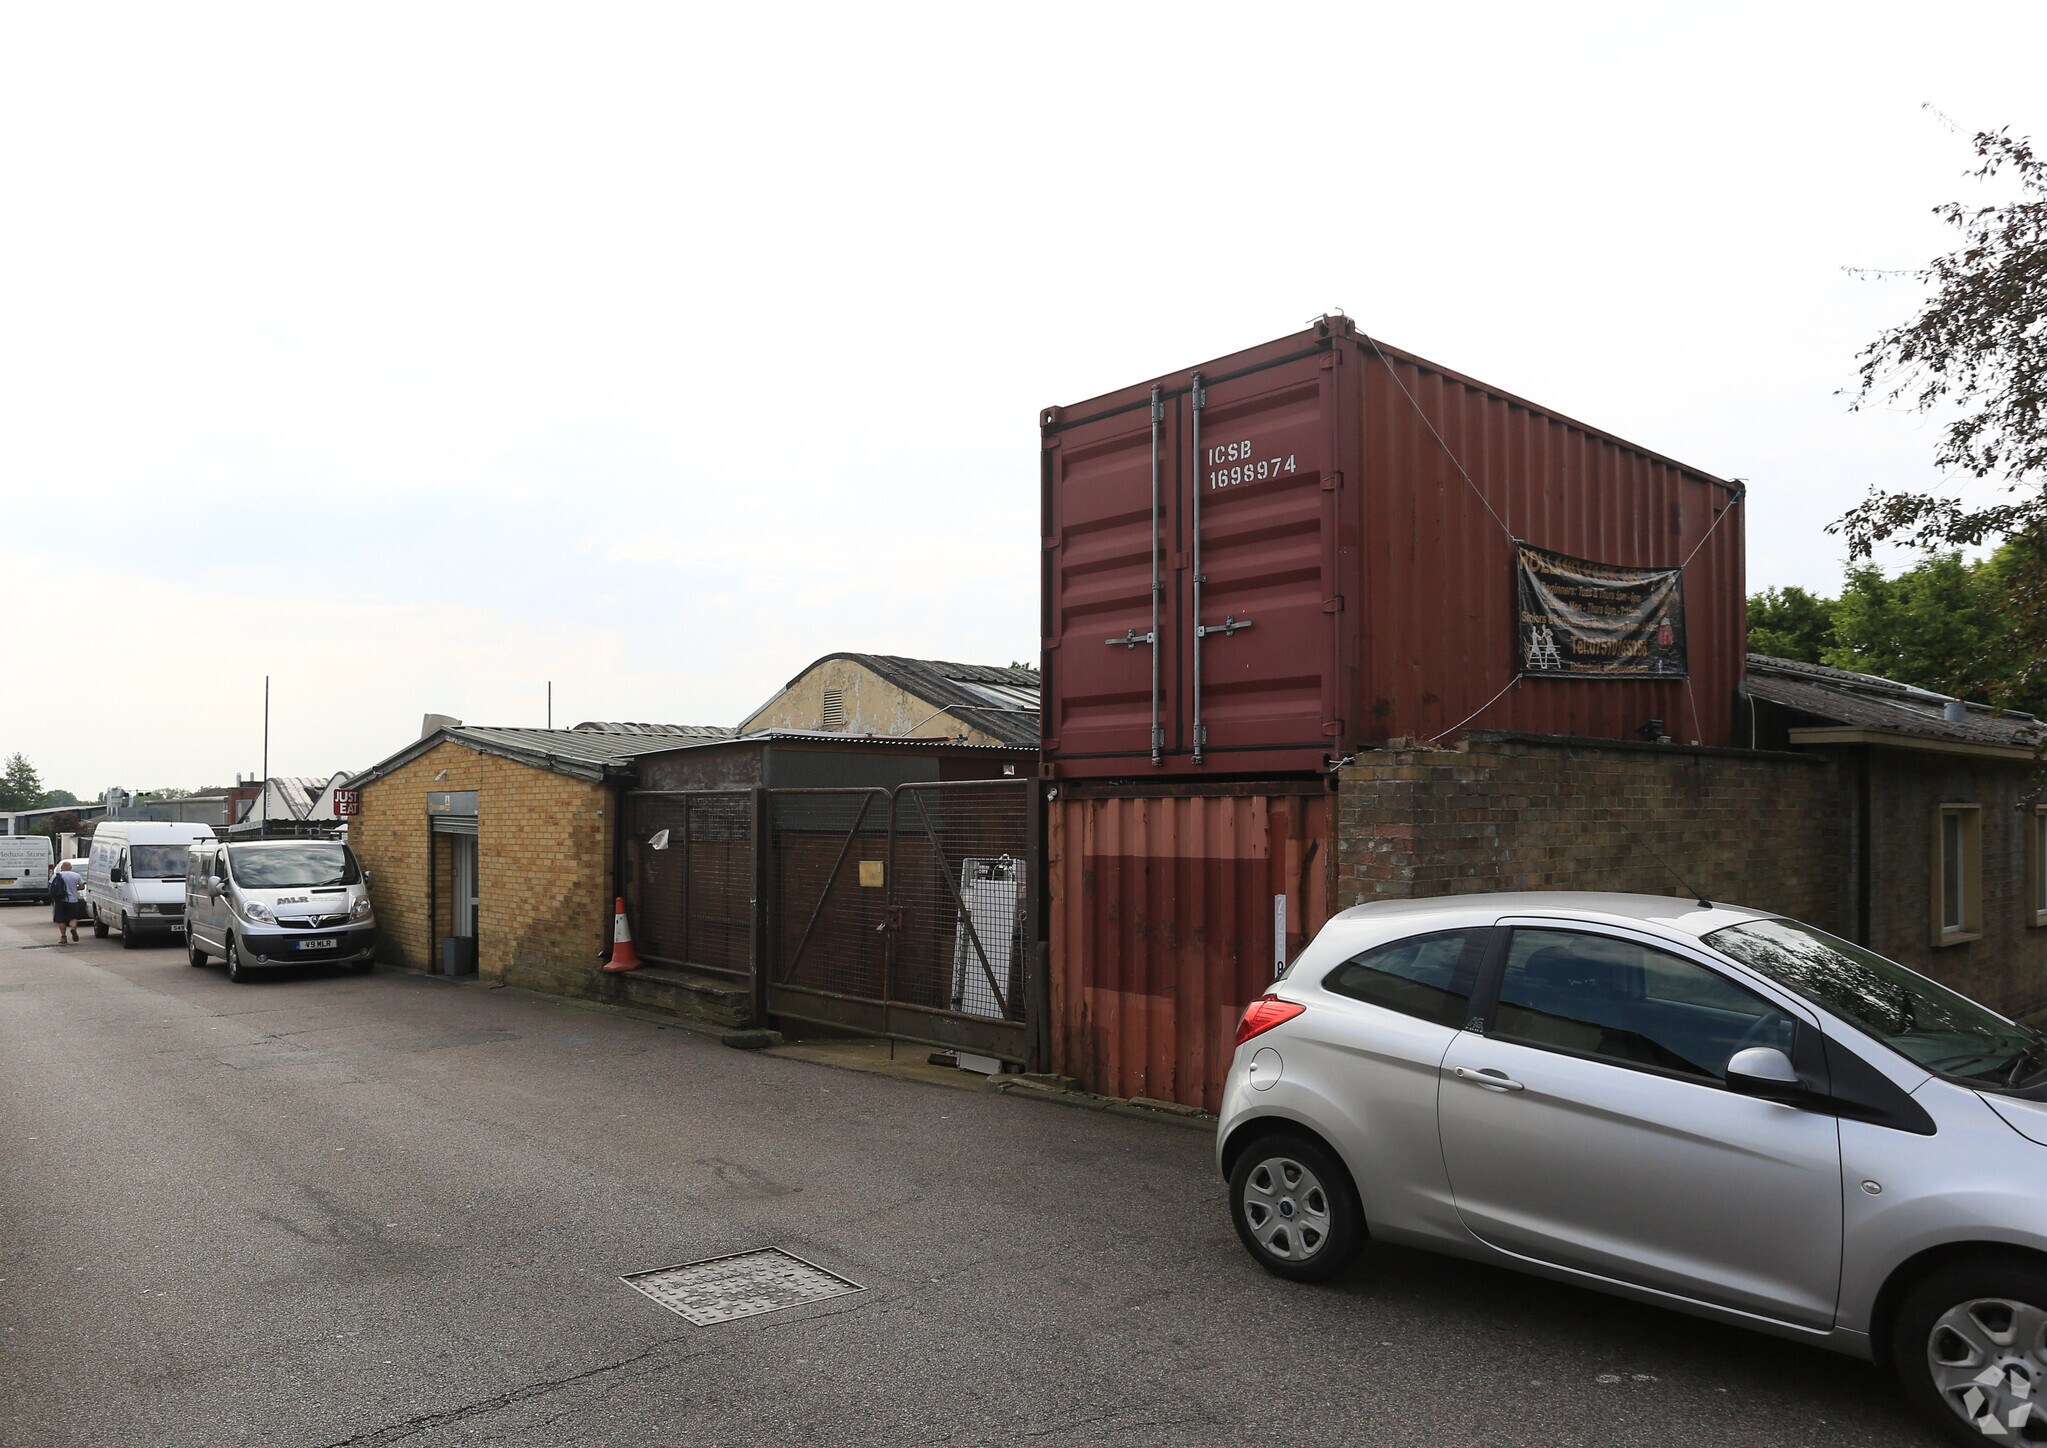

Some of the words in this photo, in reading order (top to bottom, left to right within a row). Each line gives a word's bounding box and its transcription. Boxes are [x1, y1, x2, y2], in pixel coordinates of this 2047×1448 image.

[1209, 440, 1252, 466] ICSB
[1210, 454, 1297, 490] 1698974
[1521, 610, 1547, 624] Seniors
[335, 791, 358, 803] JUST
[340, 803, 358, 814] EAT
[26, 850, 46, 858] Stone
[276, 896, 310, 906] MLR
[317, 940, 331, 948] MLR
